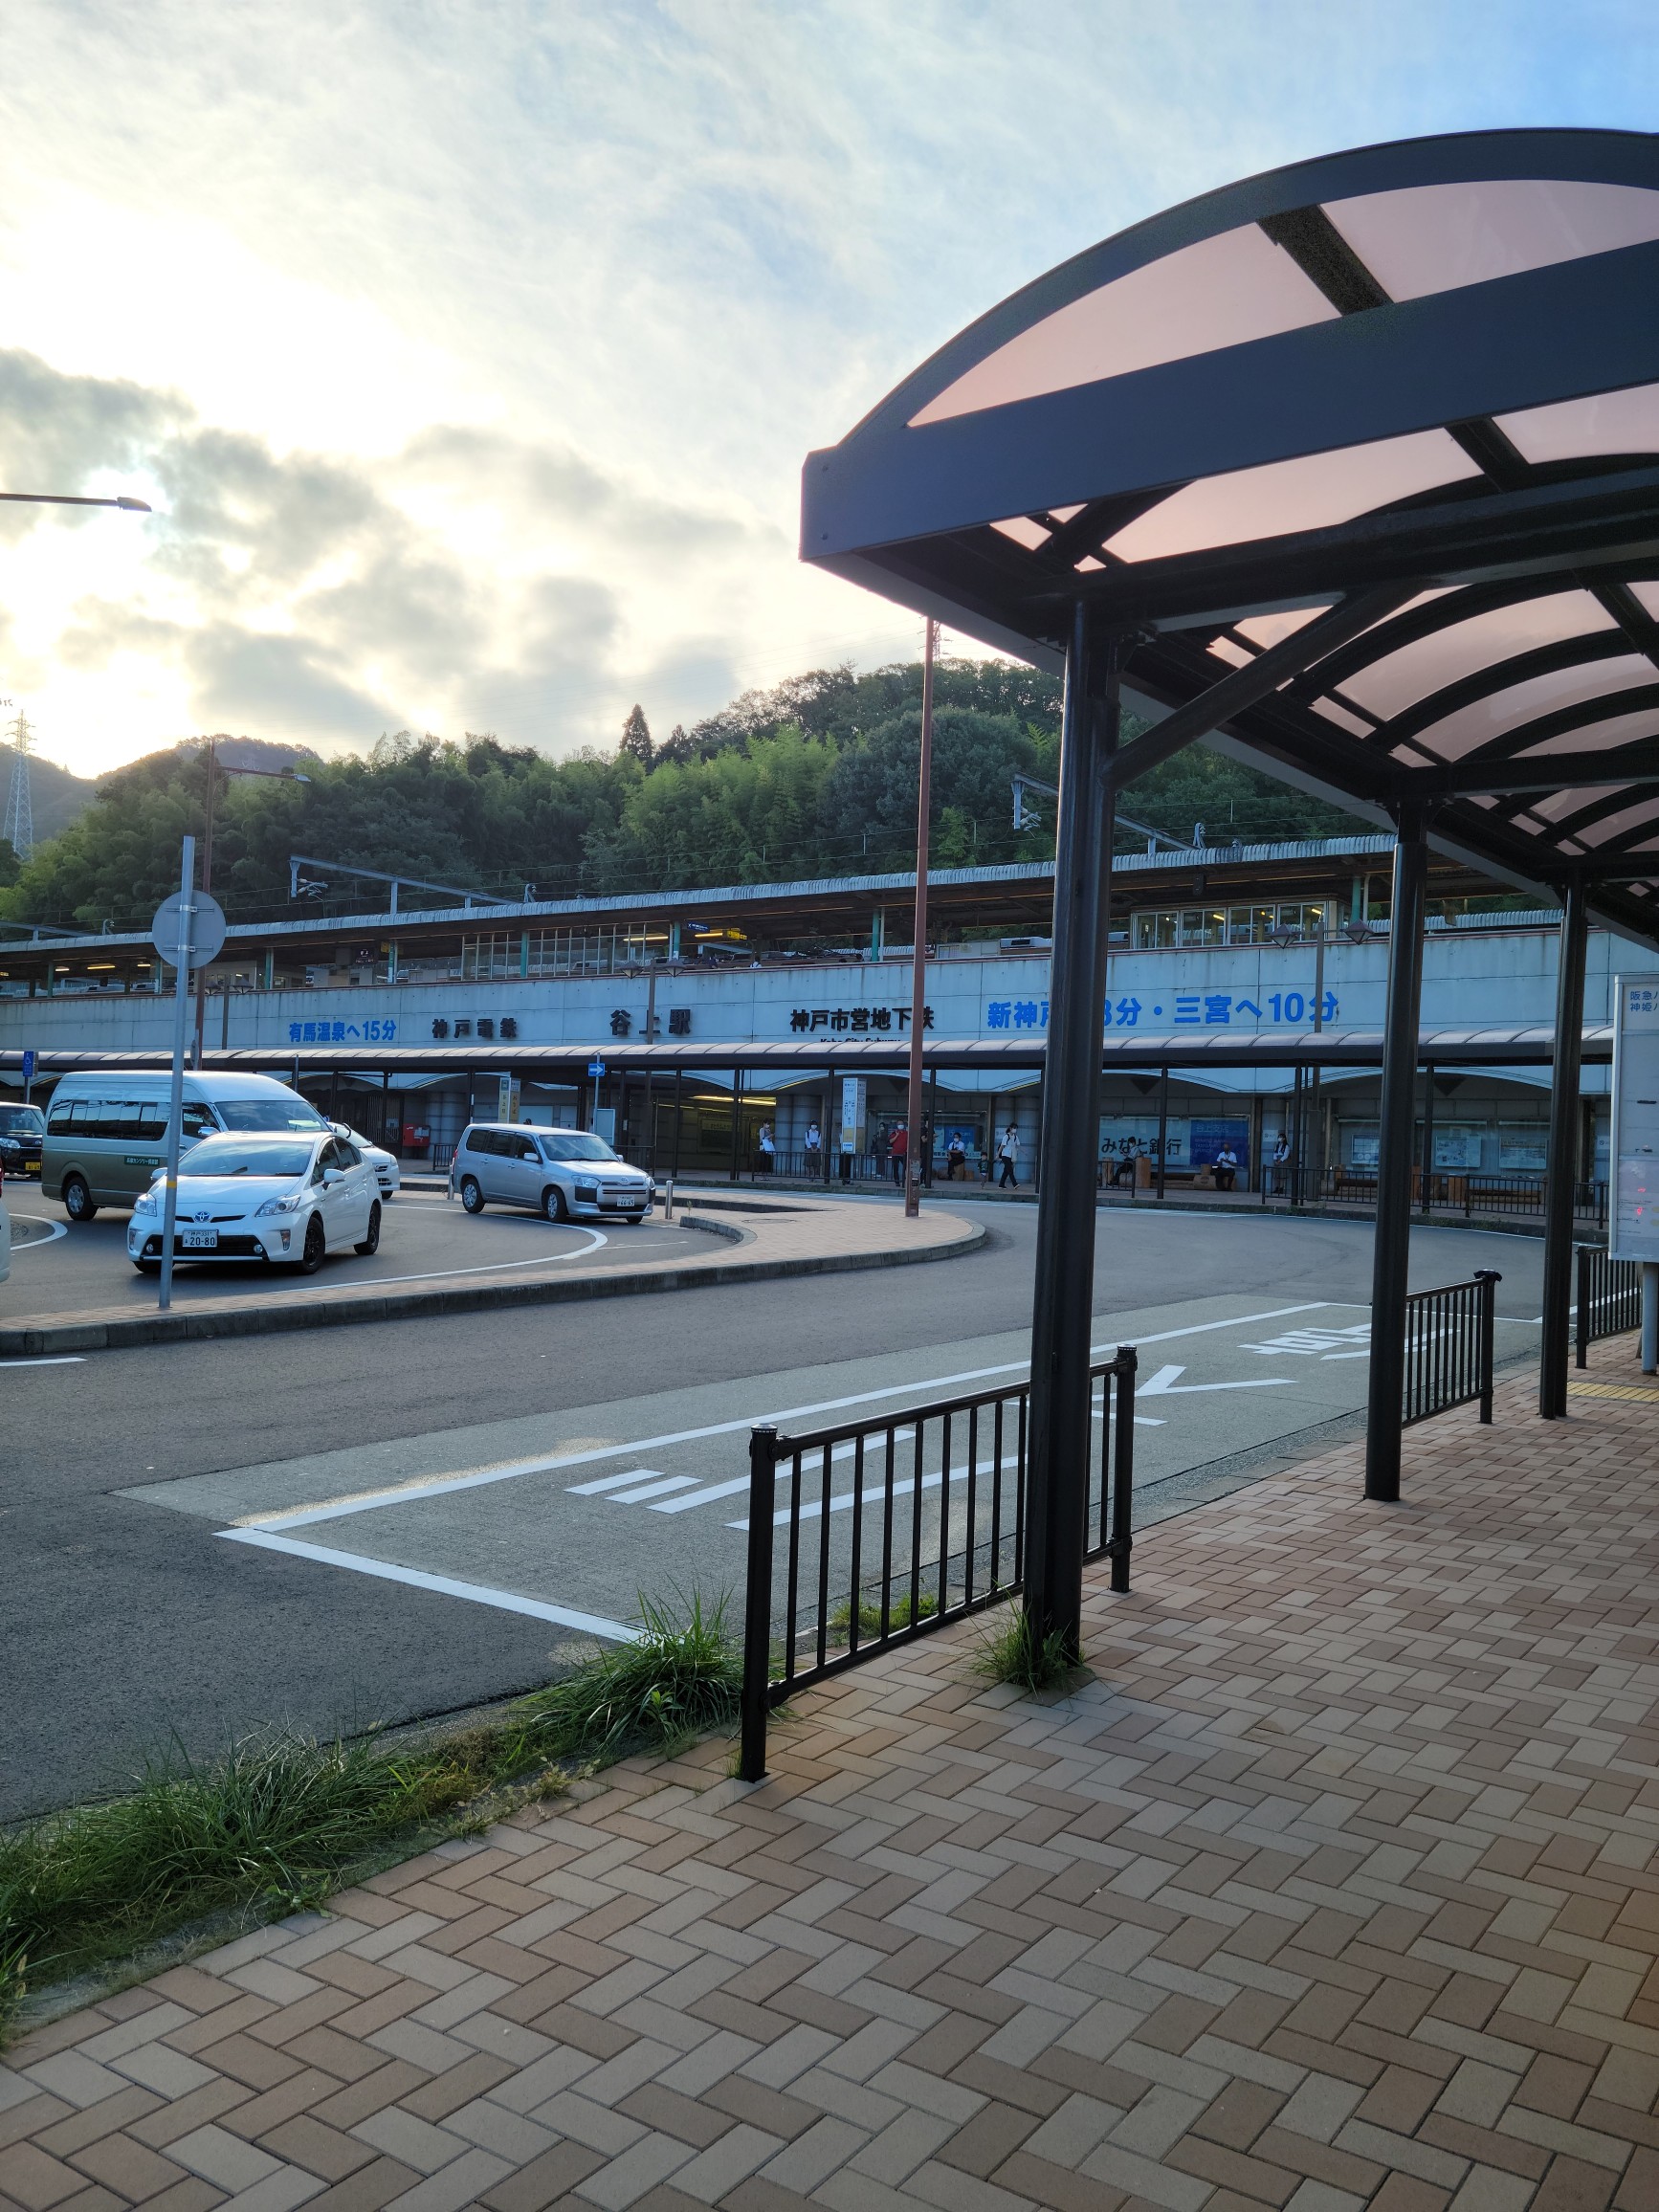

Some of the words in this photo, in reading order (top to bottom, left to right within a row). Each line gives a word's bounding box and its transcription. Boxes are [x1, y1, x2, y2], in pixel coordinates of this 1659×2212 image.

[289, 1019, 397, 1043] 有馬温泉へ15分
[431, 1017, 518, 1039] 神戸電鉄
[609, 1008, 692, 1036] 谷上駅
[189, 1236, 215, 1247] 20-80
